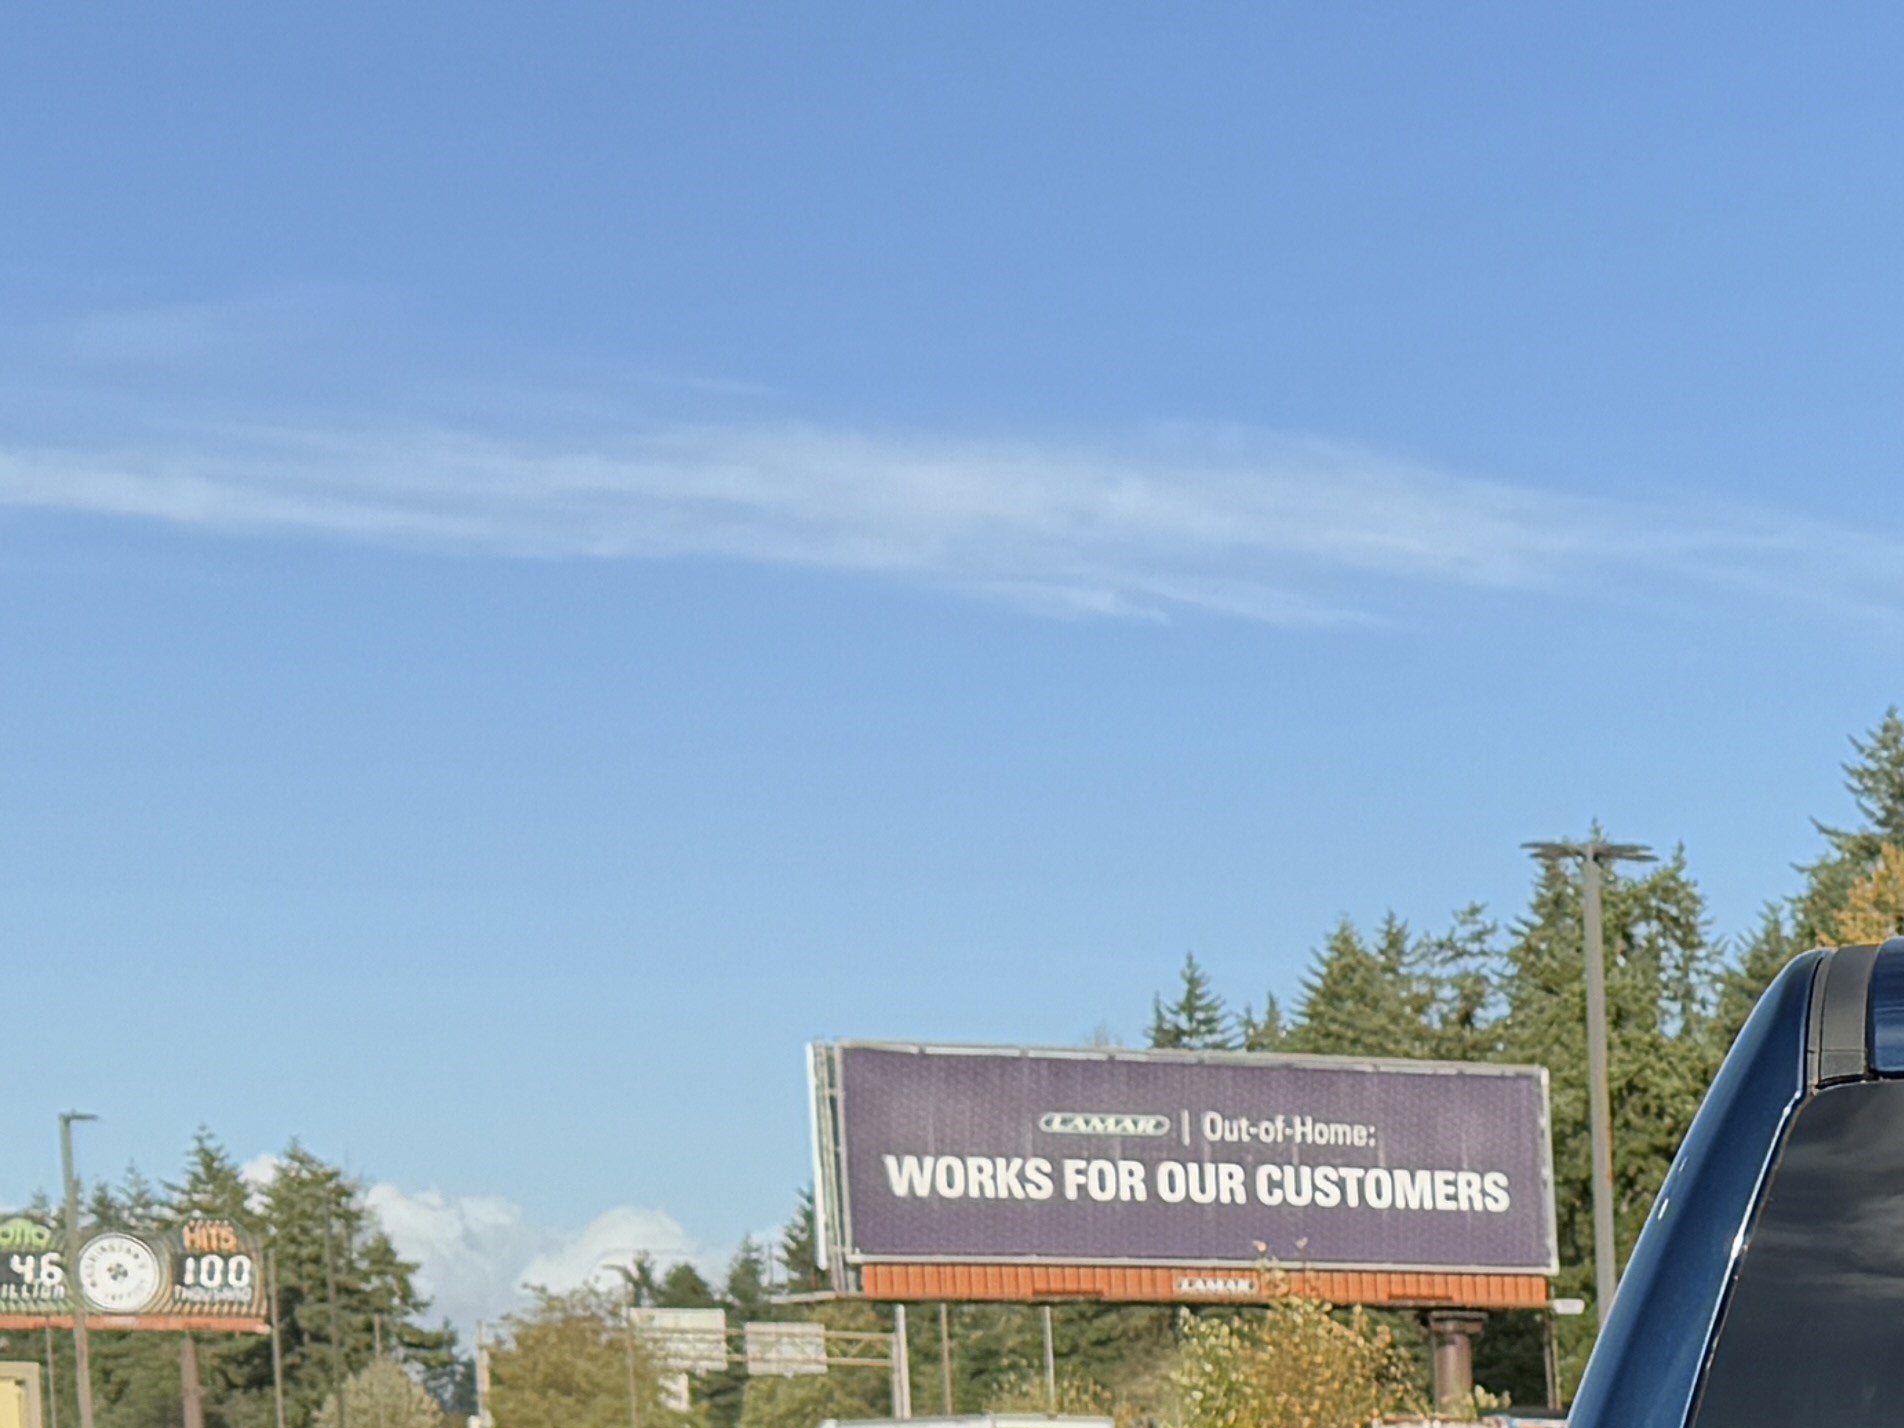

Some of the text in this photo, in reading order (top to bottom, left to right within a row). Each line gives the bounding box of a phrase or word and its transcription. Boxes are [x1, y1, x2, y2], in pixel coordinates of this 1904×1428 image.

[1204, 1111, 1376, 1147] Out-of-Home:
[882, 1154, 1511, 1212] WORKS FOR OUR CUSTOMERS
[183, 1253, 251, 1288] 100
